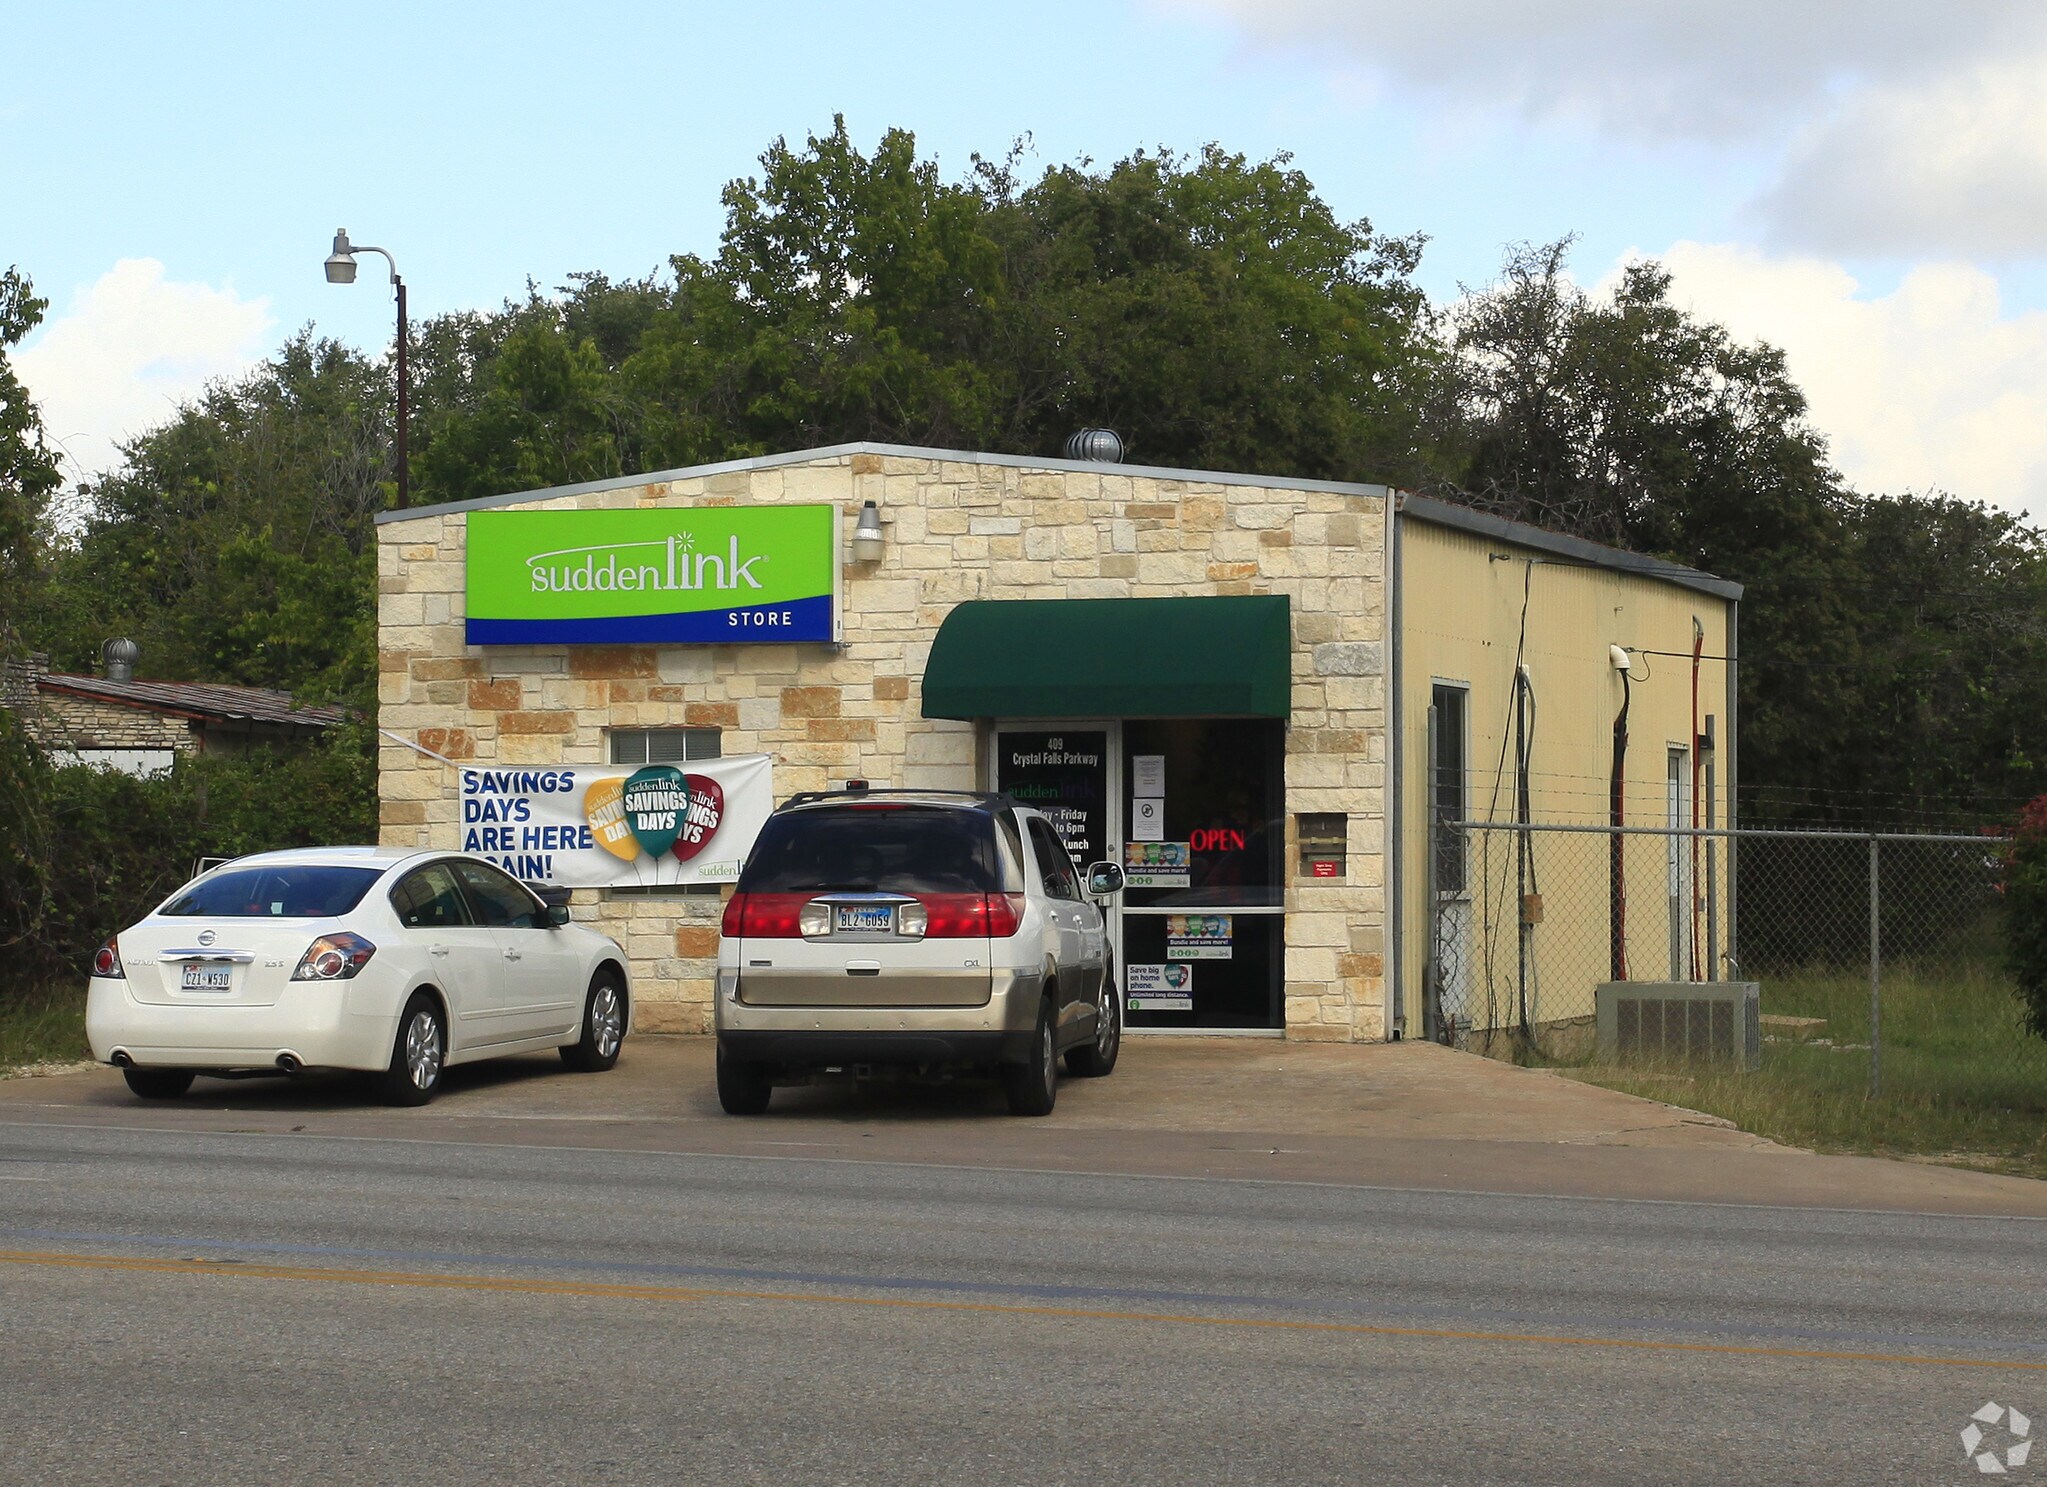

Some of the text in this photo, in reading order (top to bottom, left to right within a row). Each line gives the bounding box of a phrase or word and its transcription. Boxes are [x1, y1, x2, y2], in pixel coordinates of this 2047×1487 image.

[531, 534, 763, 592] suddenlink
[728, 612, 792, 627] STORE
[1047, 738, 1064, 750] 409
[1012, 752, 1098, 768] Crystal Falls Parkway
[463, 771, 576, 794] SAVINGS
[628, 778, 681, 793] suddenlink
[625, 791, 688, 812] SAVINGS
[464, 798, 531, 823] DAYS
[1060, 809, 1087, 822] Friday
[637, 812, 677, 831] DAYS
[1066, 822, 1085, 835] 6pm
[463, 826, 594, 852] ARE HERE
[1063, 839, 1089, 850] Lunch
[1190, 828, 1245, 851] OPEN
